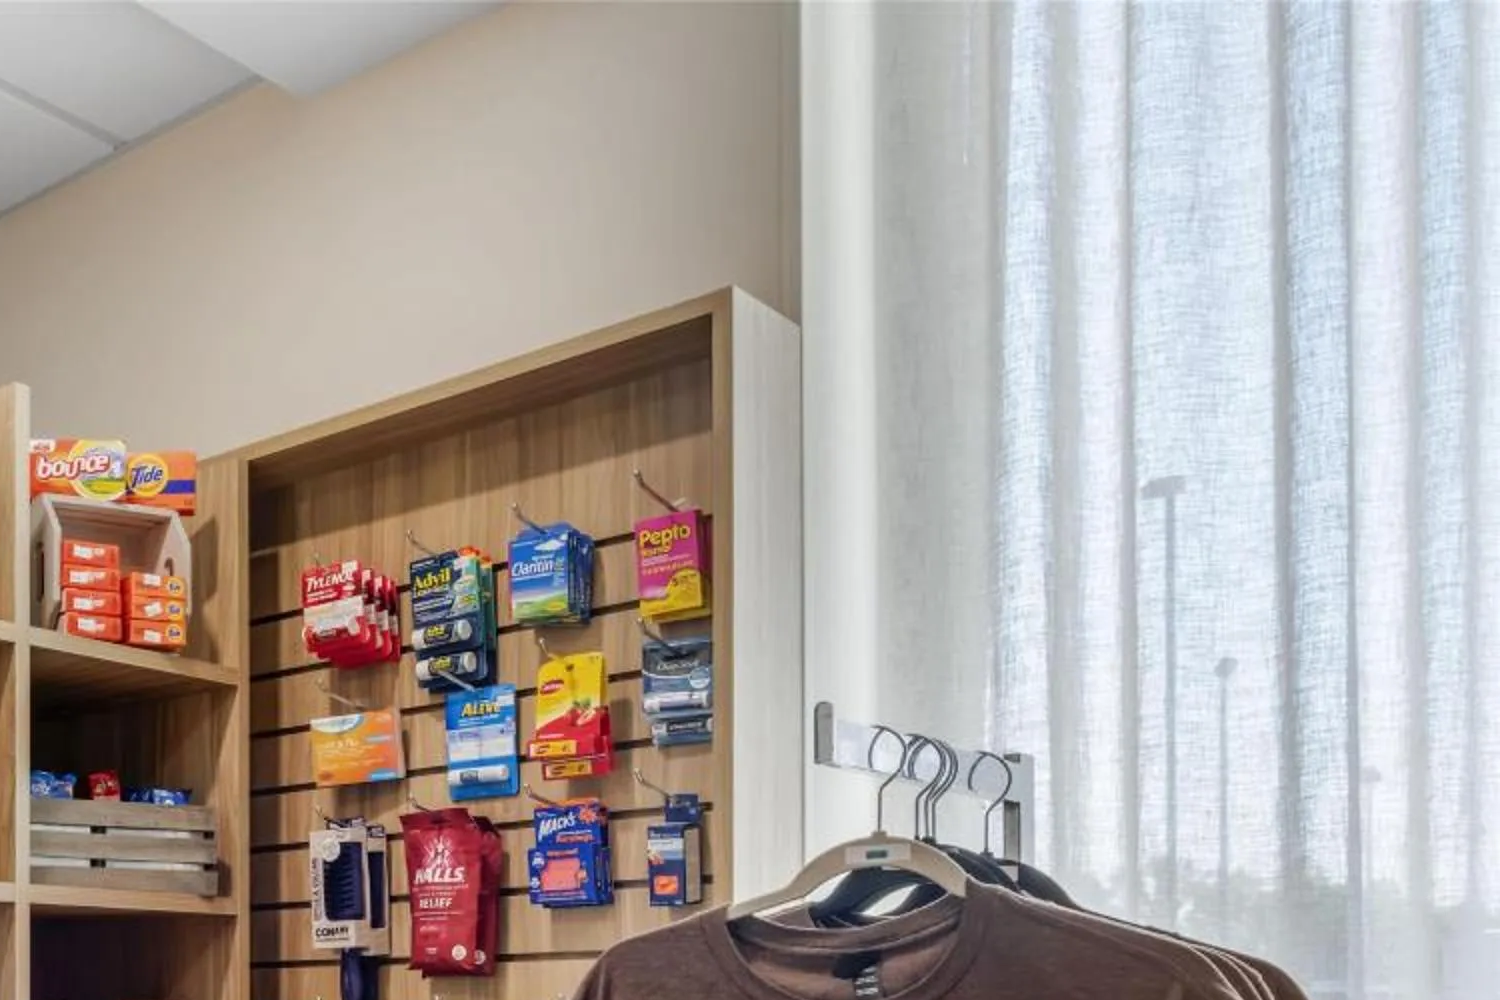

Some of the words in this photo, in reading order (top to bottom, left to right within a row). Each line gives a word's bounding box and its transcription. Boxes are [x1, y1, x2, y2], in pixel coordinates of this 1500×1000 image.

[36, 454, 110, 480] bounce
[130, 465, 164, 489] Tide
[640, 524, 692, 549] Pepto
[414, 567, 451, 593] Advil
